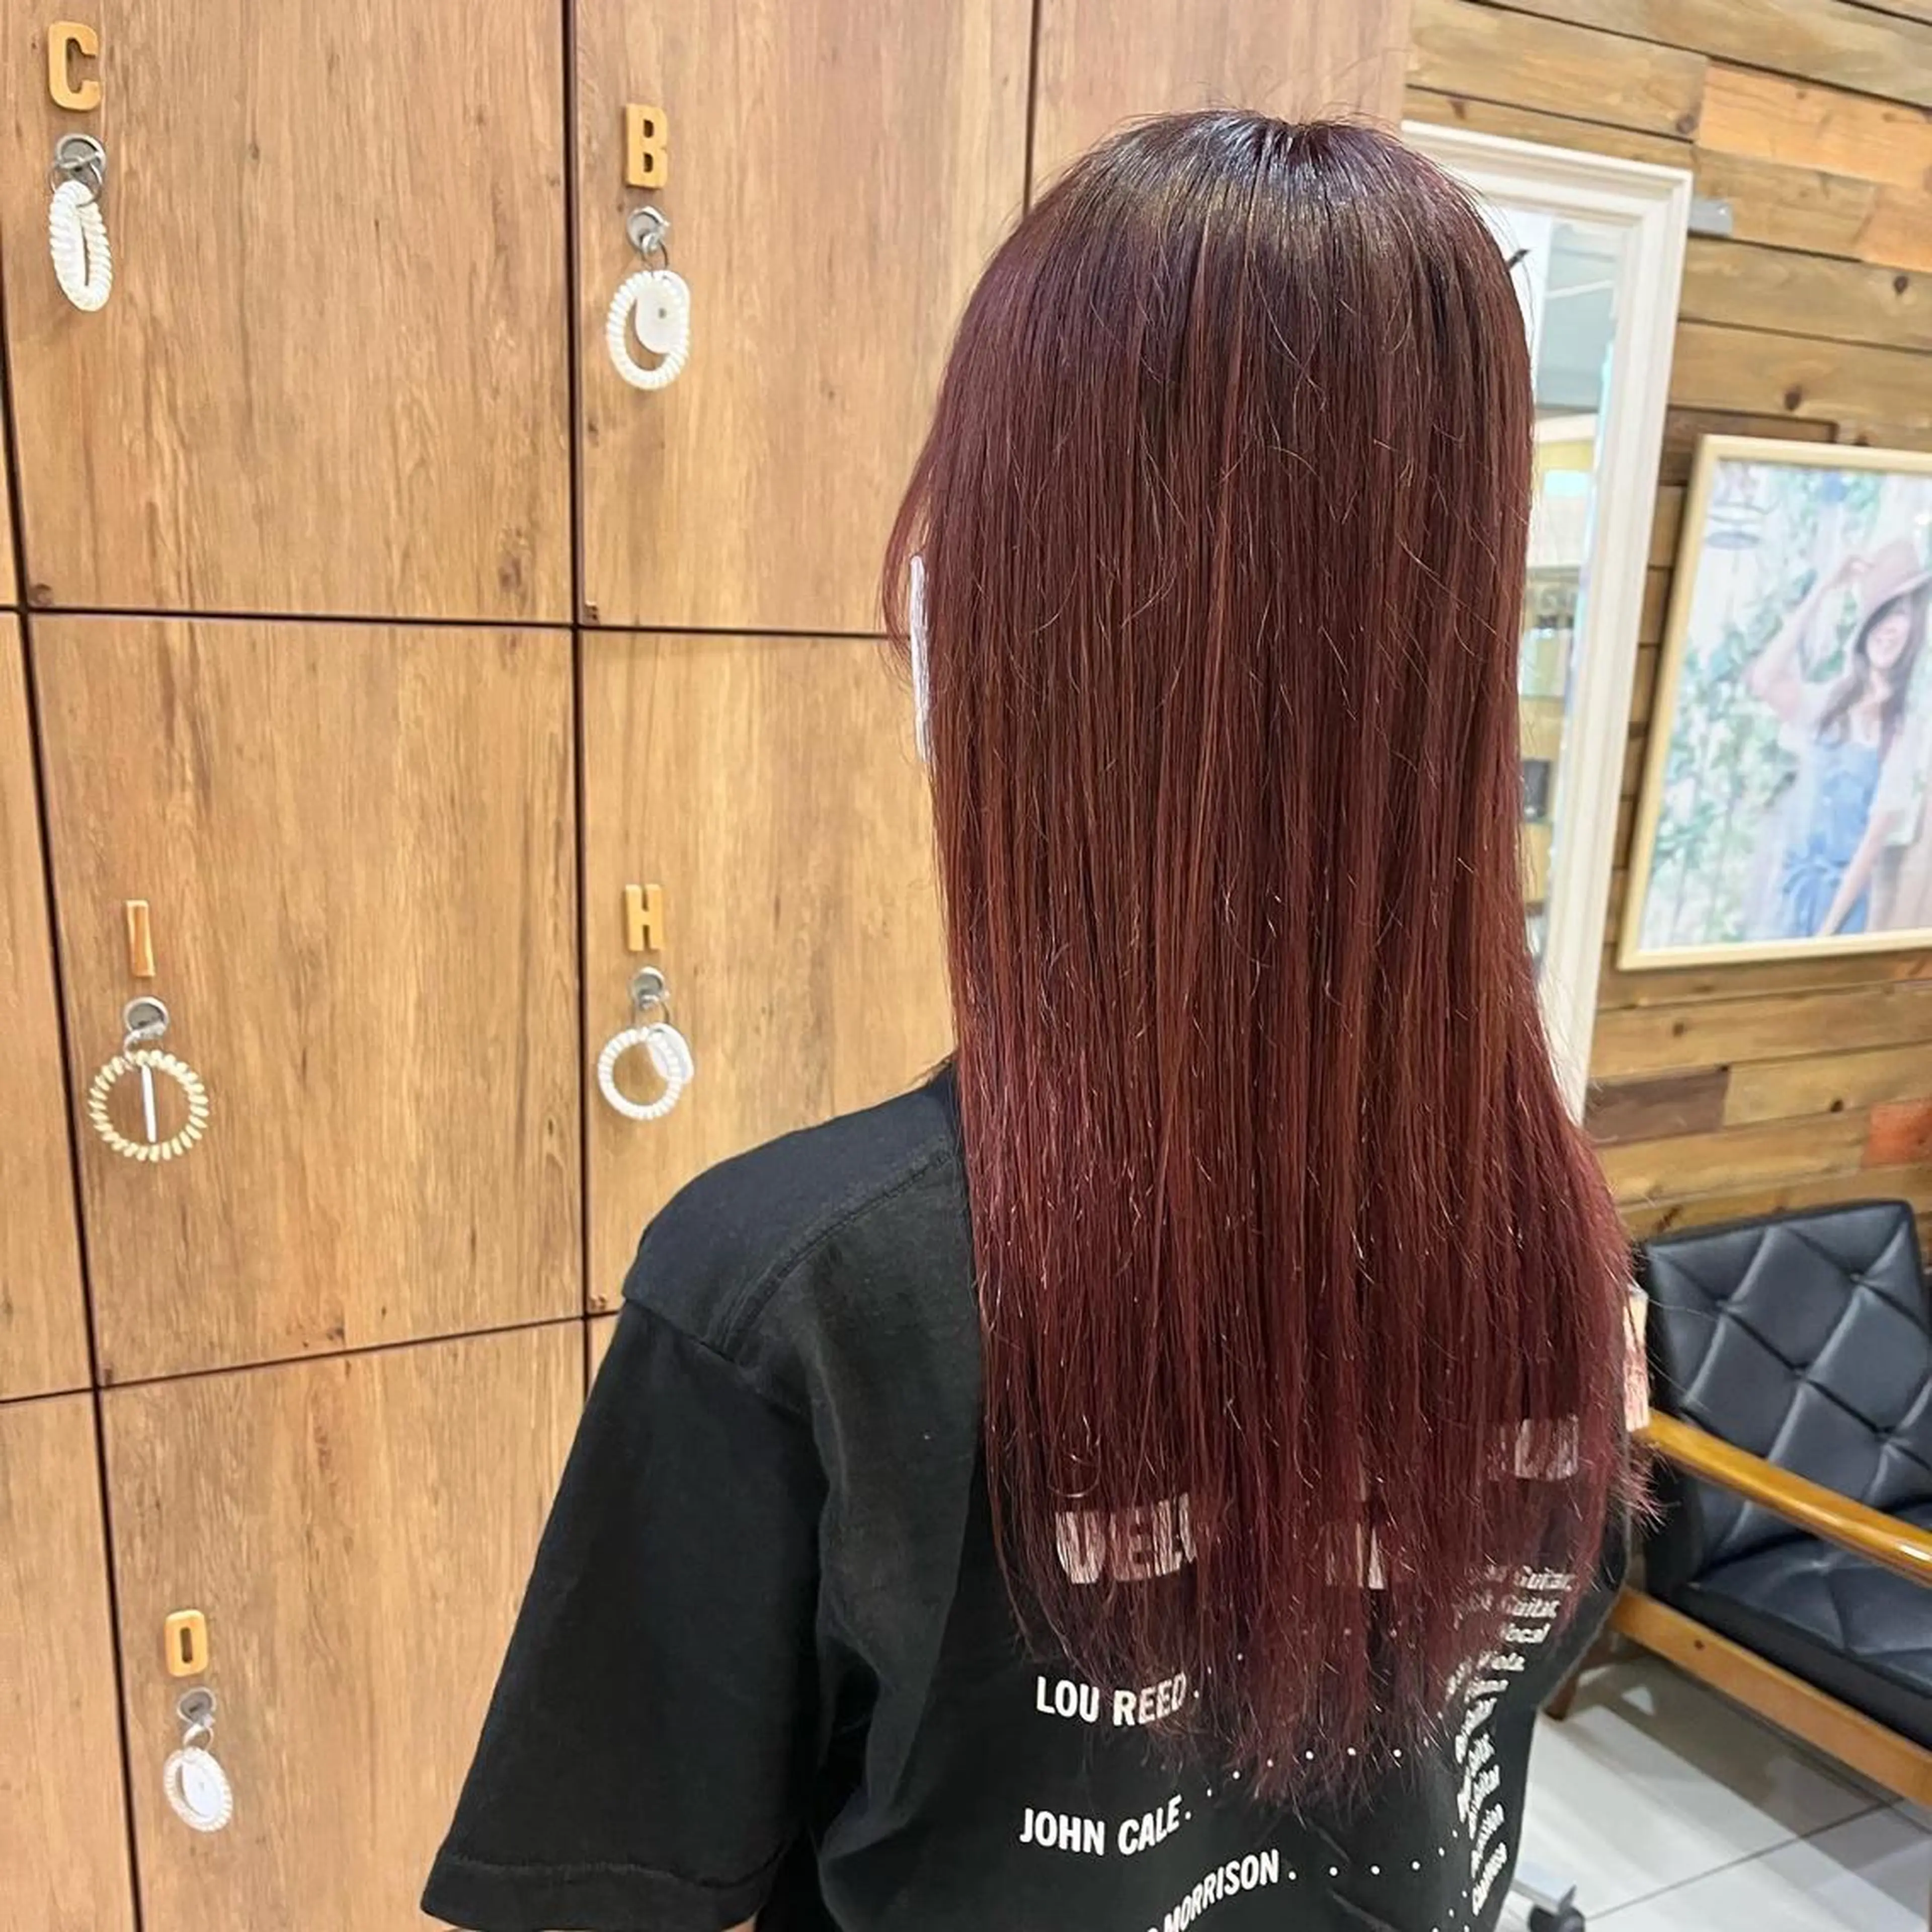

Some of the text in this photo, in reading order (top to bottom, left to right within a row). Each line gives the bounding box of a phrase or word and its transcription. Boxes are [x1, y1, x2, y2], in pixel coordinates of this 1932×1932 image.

[48, 21, 101, 110] C
[626, 104, 668, 188] B
[127, 900, 155, 976] I
[625, 884, 665, 951] H
[166, 1610, 208, 1677] O
[1037, 1671, 1186, 1726] LOU REED
[1019, 1794, 1182, 1856] JOHN CALE
[1164, 1848, 1279, 1932] MORRISON
